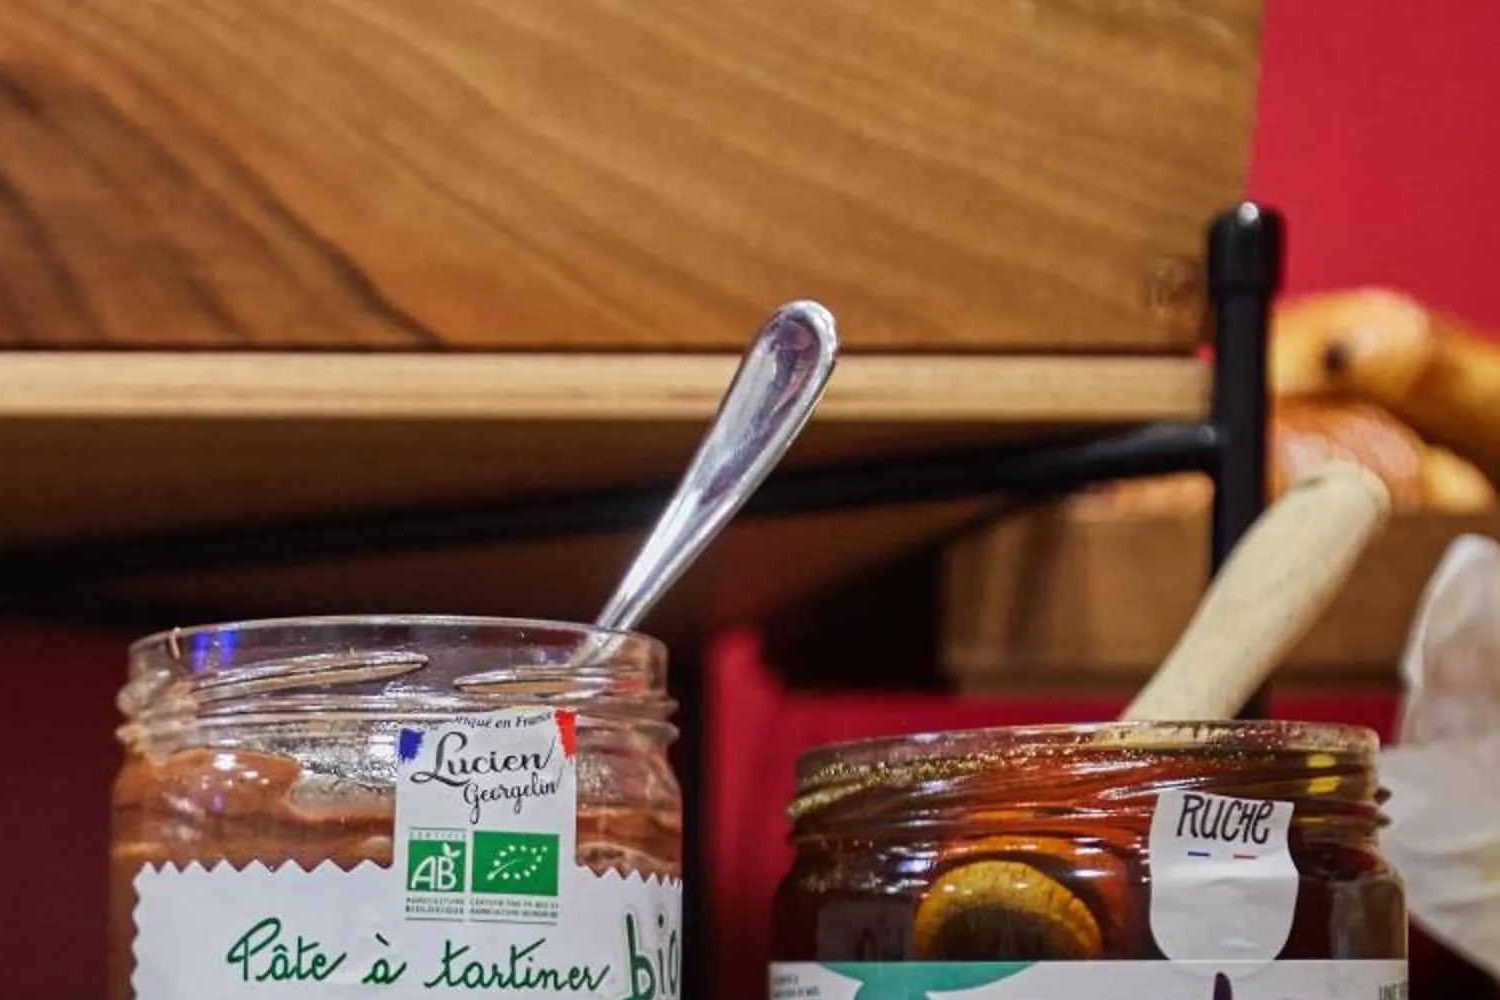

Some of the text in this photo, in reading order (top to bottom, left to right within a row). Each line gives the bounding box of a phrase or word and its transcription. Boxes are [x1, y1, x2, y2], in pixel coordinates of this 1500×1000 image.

[410, 731, 556, 787] Lucien
[463, 764, 565, 825] Georgelin
[411, 855, 457, 890] AB
[226, 916, 611, 992] Pâte à tartiner
